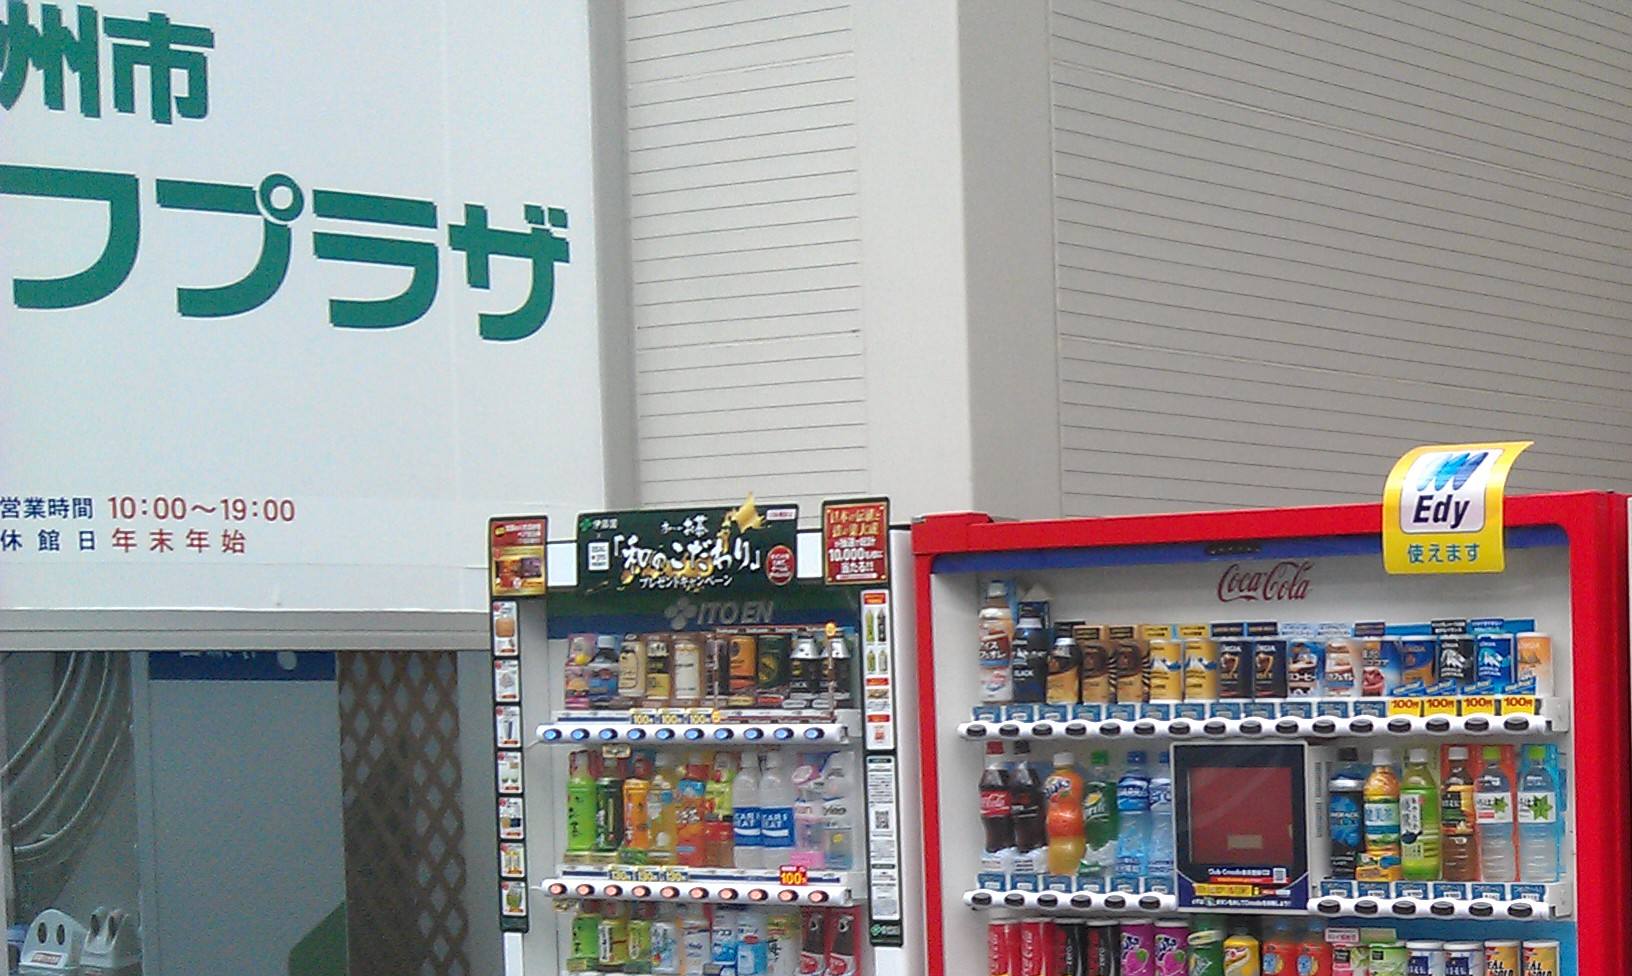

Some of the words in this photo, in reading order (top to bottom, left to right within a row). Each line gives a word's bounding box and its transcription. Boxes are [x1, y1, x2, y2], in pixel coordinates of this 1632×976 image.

[0, 497, 94, 519] 営業時間
[1412, 494, 1470, 529] Edy
[112, 530, 247, 553] 年末年始
[1408, 543, 1479, 563] 使えます
[1218, 561, 1315, 602] Coca-Cola
[698, 602, 740, 624] ITO
[741, 601, 775, 622] EN
[1391, 699, 1419, 708] 100円
[1428, 699, 1455, 708] 100円
[1465, 699, 1493, 708] 100円
[1504, 698, 1533, 707] 100円
